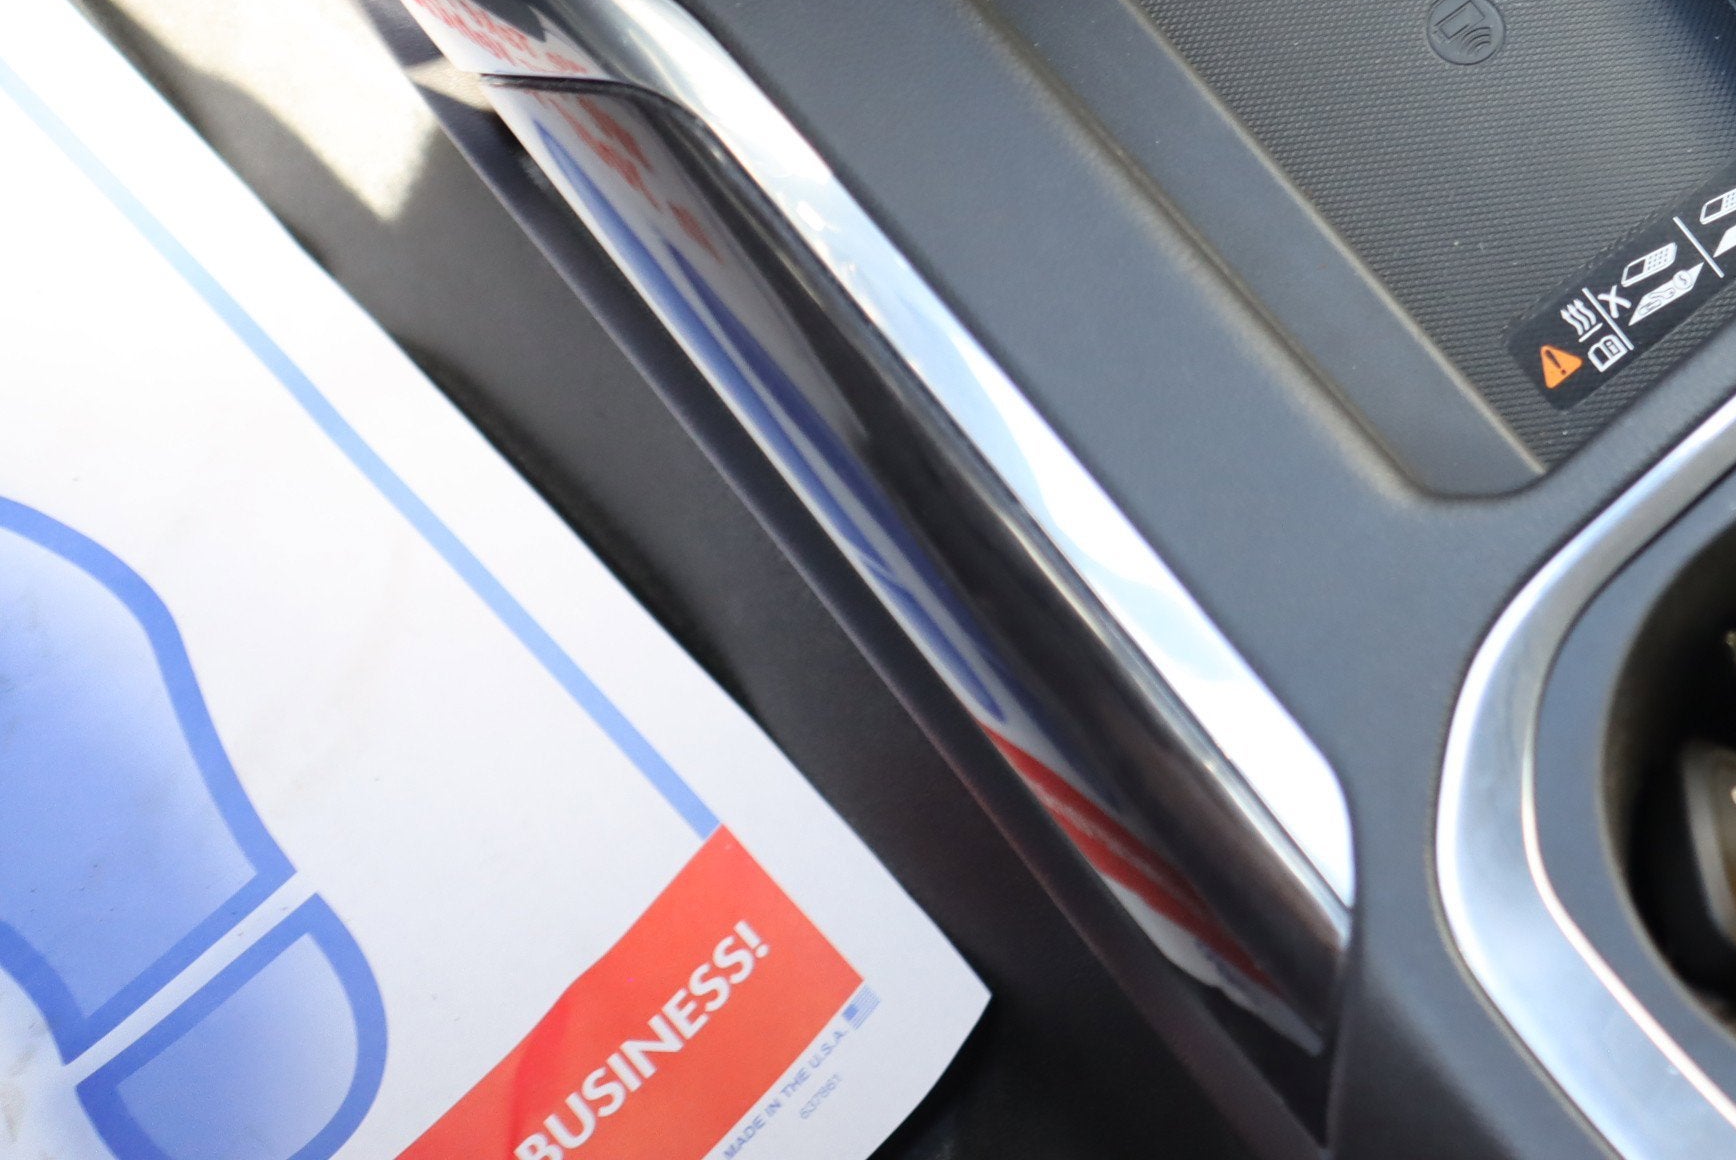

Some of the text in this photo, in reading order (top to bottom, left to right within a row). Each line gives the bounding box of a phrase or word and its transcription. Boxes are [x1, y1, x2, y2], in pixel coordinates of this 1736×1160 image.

[513, 919, 769, 1160] BUSINESS!
[724, 1115, 766, 1159] MADE
[765, 1099, 782, 1117] IN
[781, 1068, 811, 1097] THE
